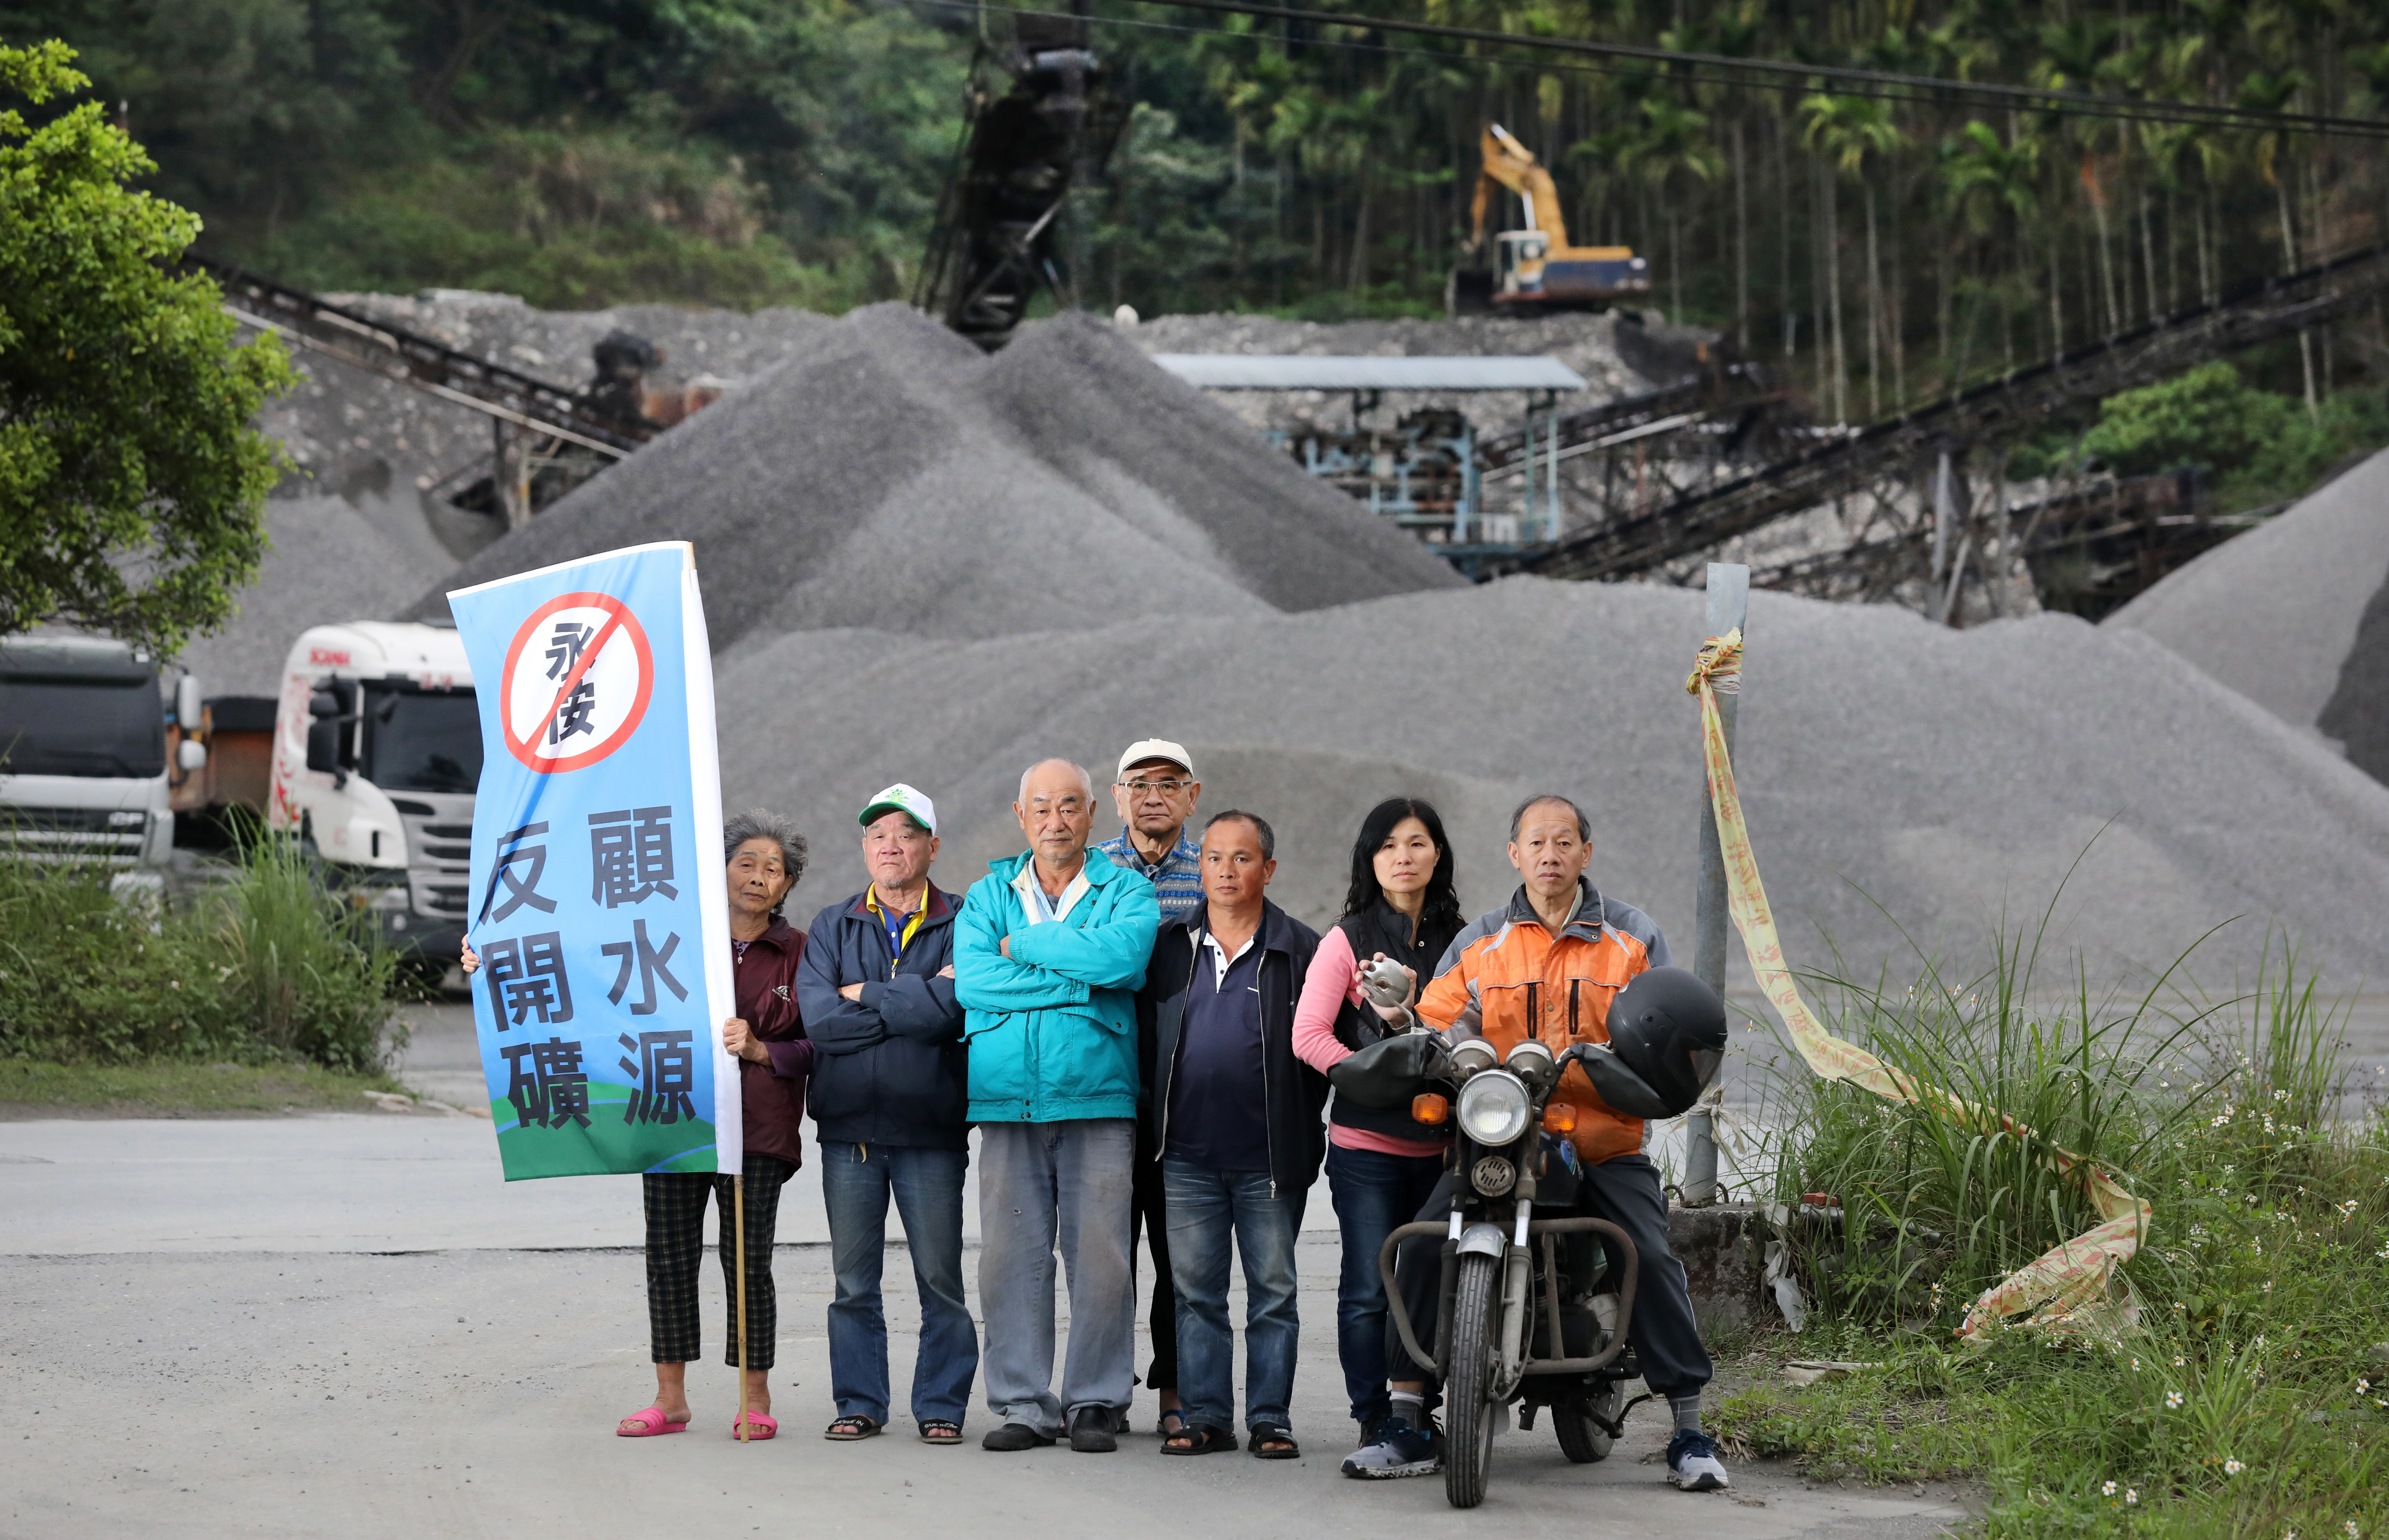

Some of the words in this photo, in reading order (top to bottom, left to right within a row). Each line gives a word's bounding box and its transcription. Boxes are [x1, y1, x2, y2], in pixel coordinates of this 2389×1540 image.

[545, 623, 596, 745] 永安
[479, 821, 593, 1130] 反開礦
[588, 806, 696, 1127] 顧水源
